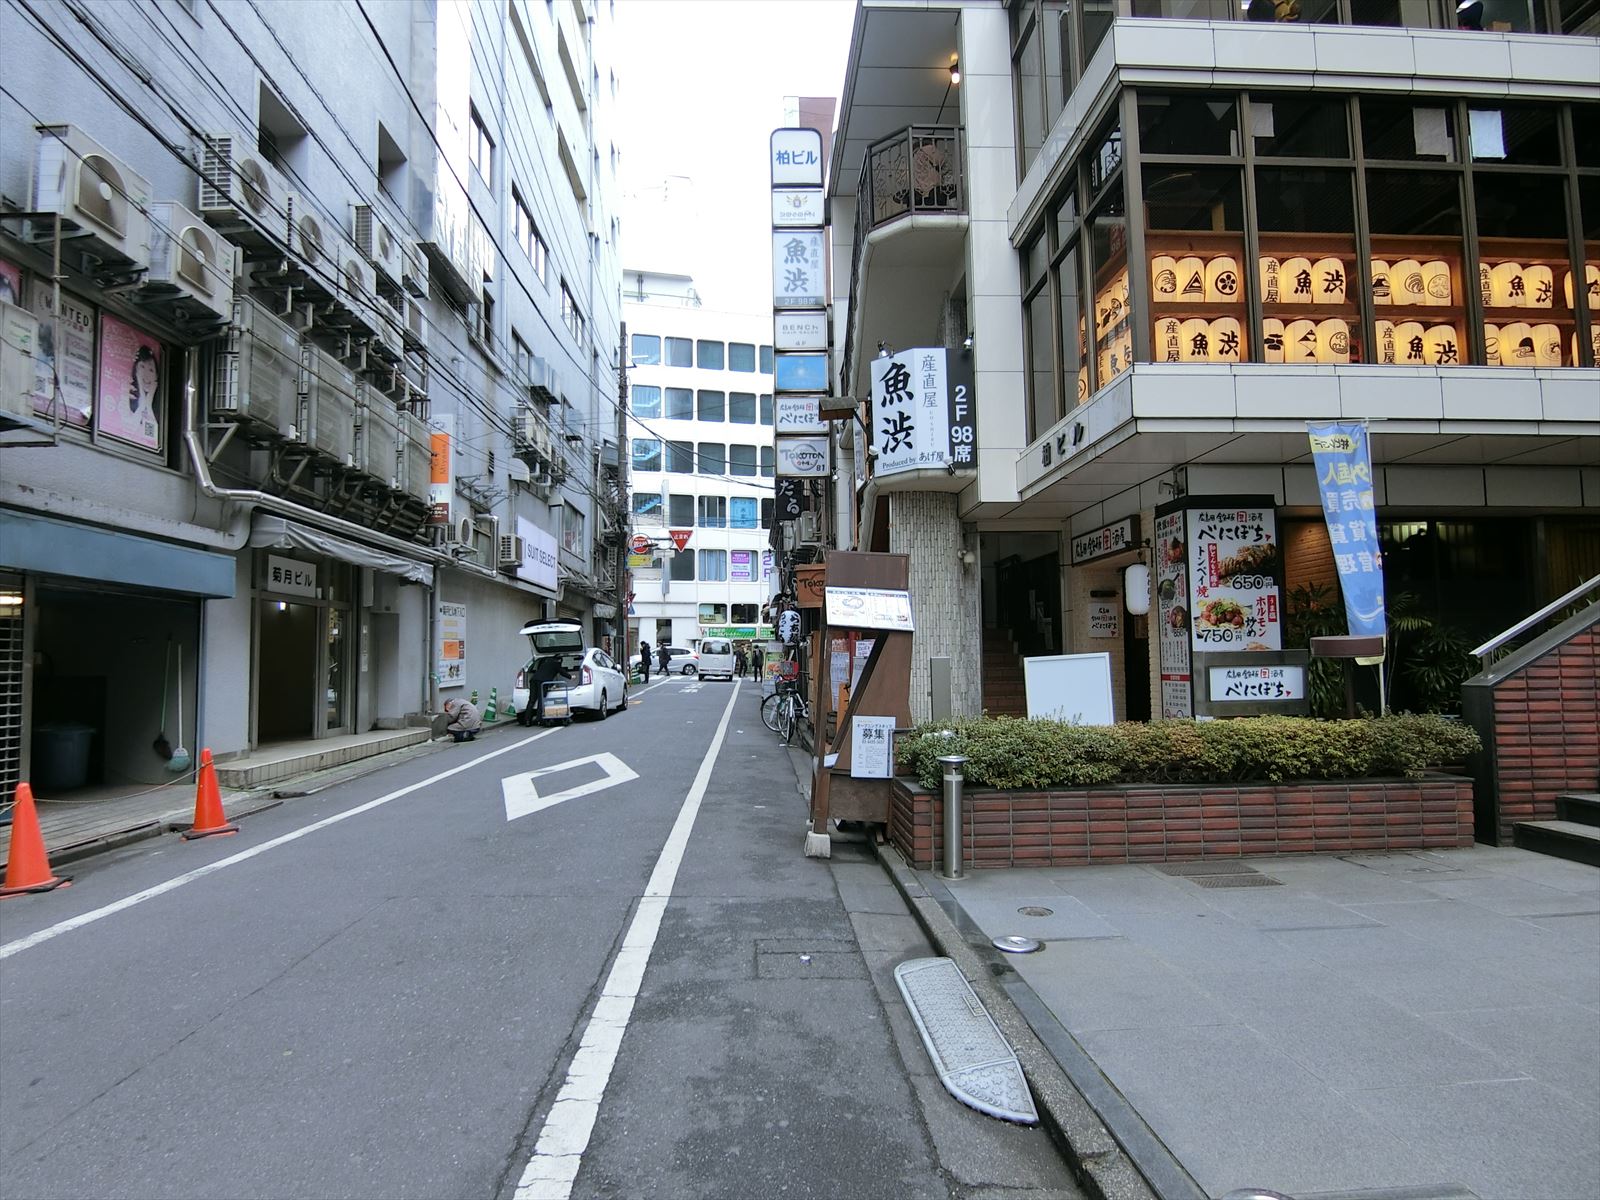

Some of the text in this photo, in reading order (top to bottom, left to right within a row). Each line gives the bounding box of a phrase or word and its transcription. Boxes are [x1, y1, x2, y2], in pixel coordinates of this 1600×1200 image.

[775, 149, 818, 166] 柏ビル
[783, 237, 809, 293] 魚渋
[1264, 259, 1279, 304] 産直屋
[44, 294, 90, 328] WNTED
[1165, 320, 1181, 363] 産直屋
[1381, 326, 1396, 364] 産直屋
[921, 354, 938, 408] 産直屋
[779, 412, 824, 426] べにぼ
[879, 362, 915, 455] 魚渋
[882, 451, 944, 469] Produced by あげ屋
[1041, 421, 1085, 467] 柏ビル
[778, 479, 800, 514] たる
[1198, 524, 1264, 542] べにぼち
[527, 543, 557, 570] SUIT SELECT
[272, 566, 313, 588] 菊月ビル
[1091, 621, 1118, 630] べにぼち
[1255, 596, 1267, 638] ホルモン
[1225, 681, 1285, 698] べにぼち
[862, 728, 885, 740] 募集
